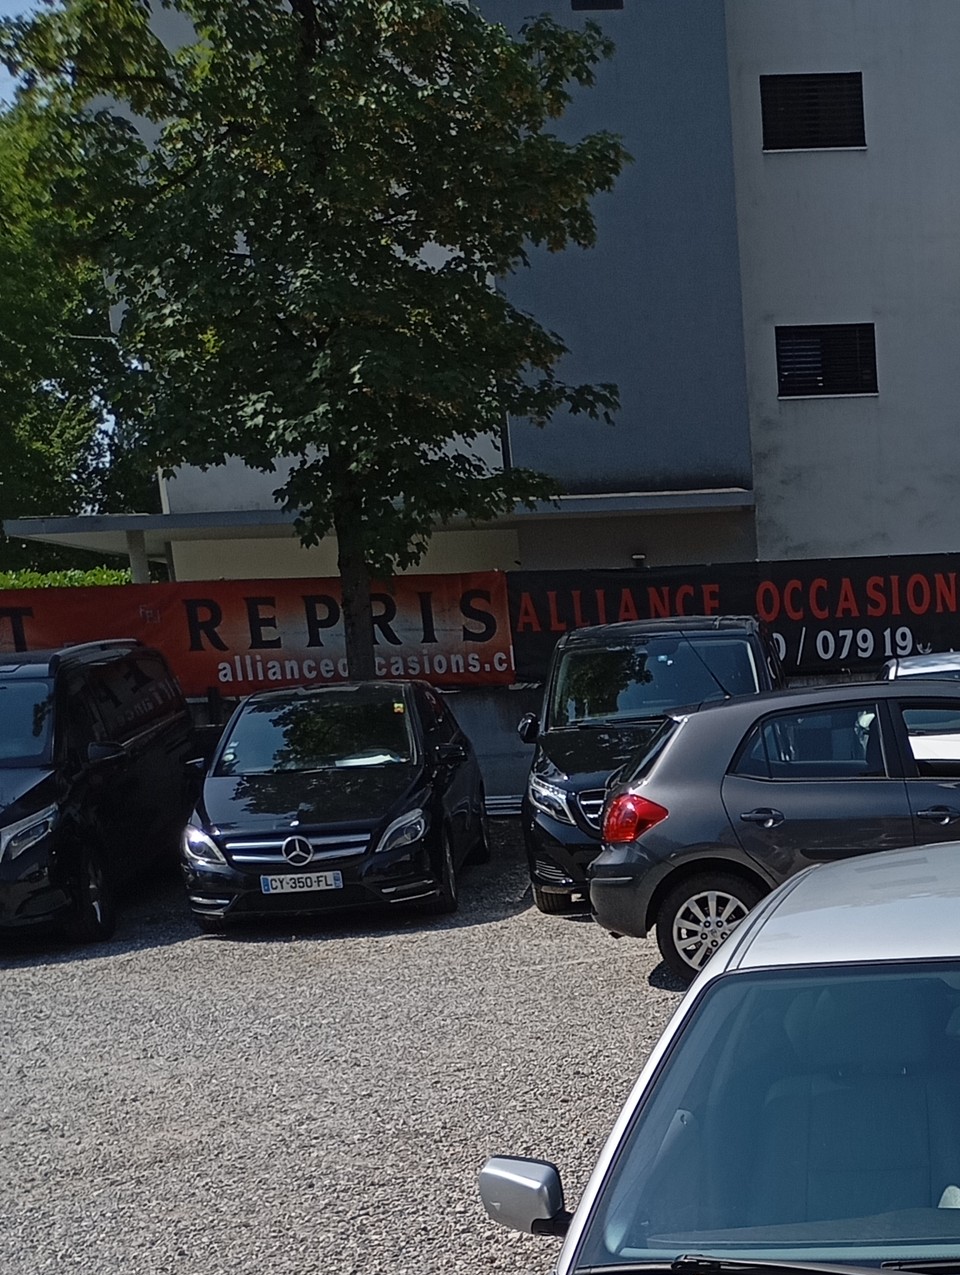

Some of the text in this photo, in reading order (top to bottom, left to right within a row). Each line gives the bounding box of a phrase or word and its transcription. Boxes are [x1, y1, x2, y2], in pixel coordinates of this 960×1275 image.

[183, 590, 498, 652] REPRIS
[516, 584, 720, 632] ALLIANCE
[218, 645, 516, 683] allianceocasions.c
[270, 875, 333, 890] CY-350-FL
